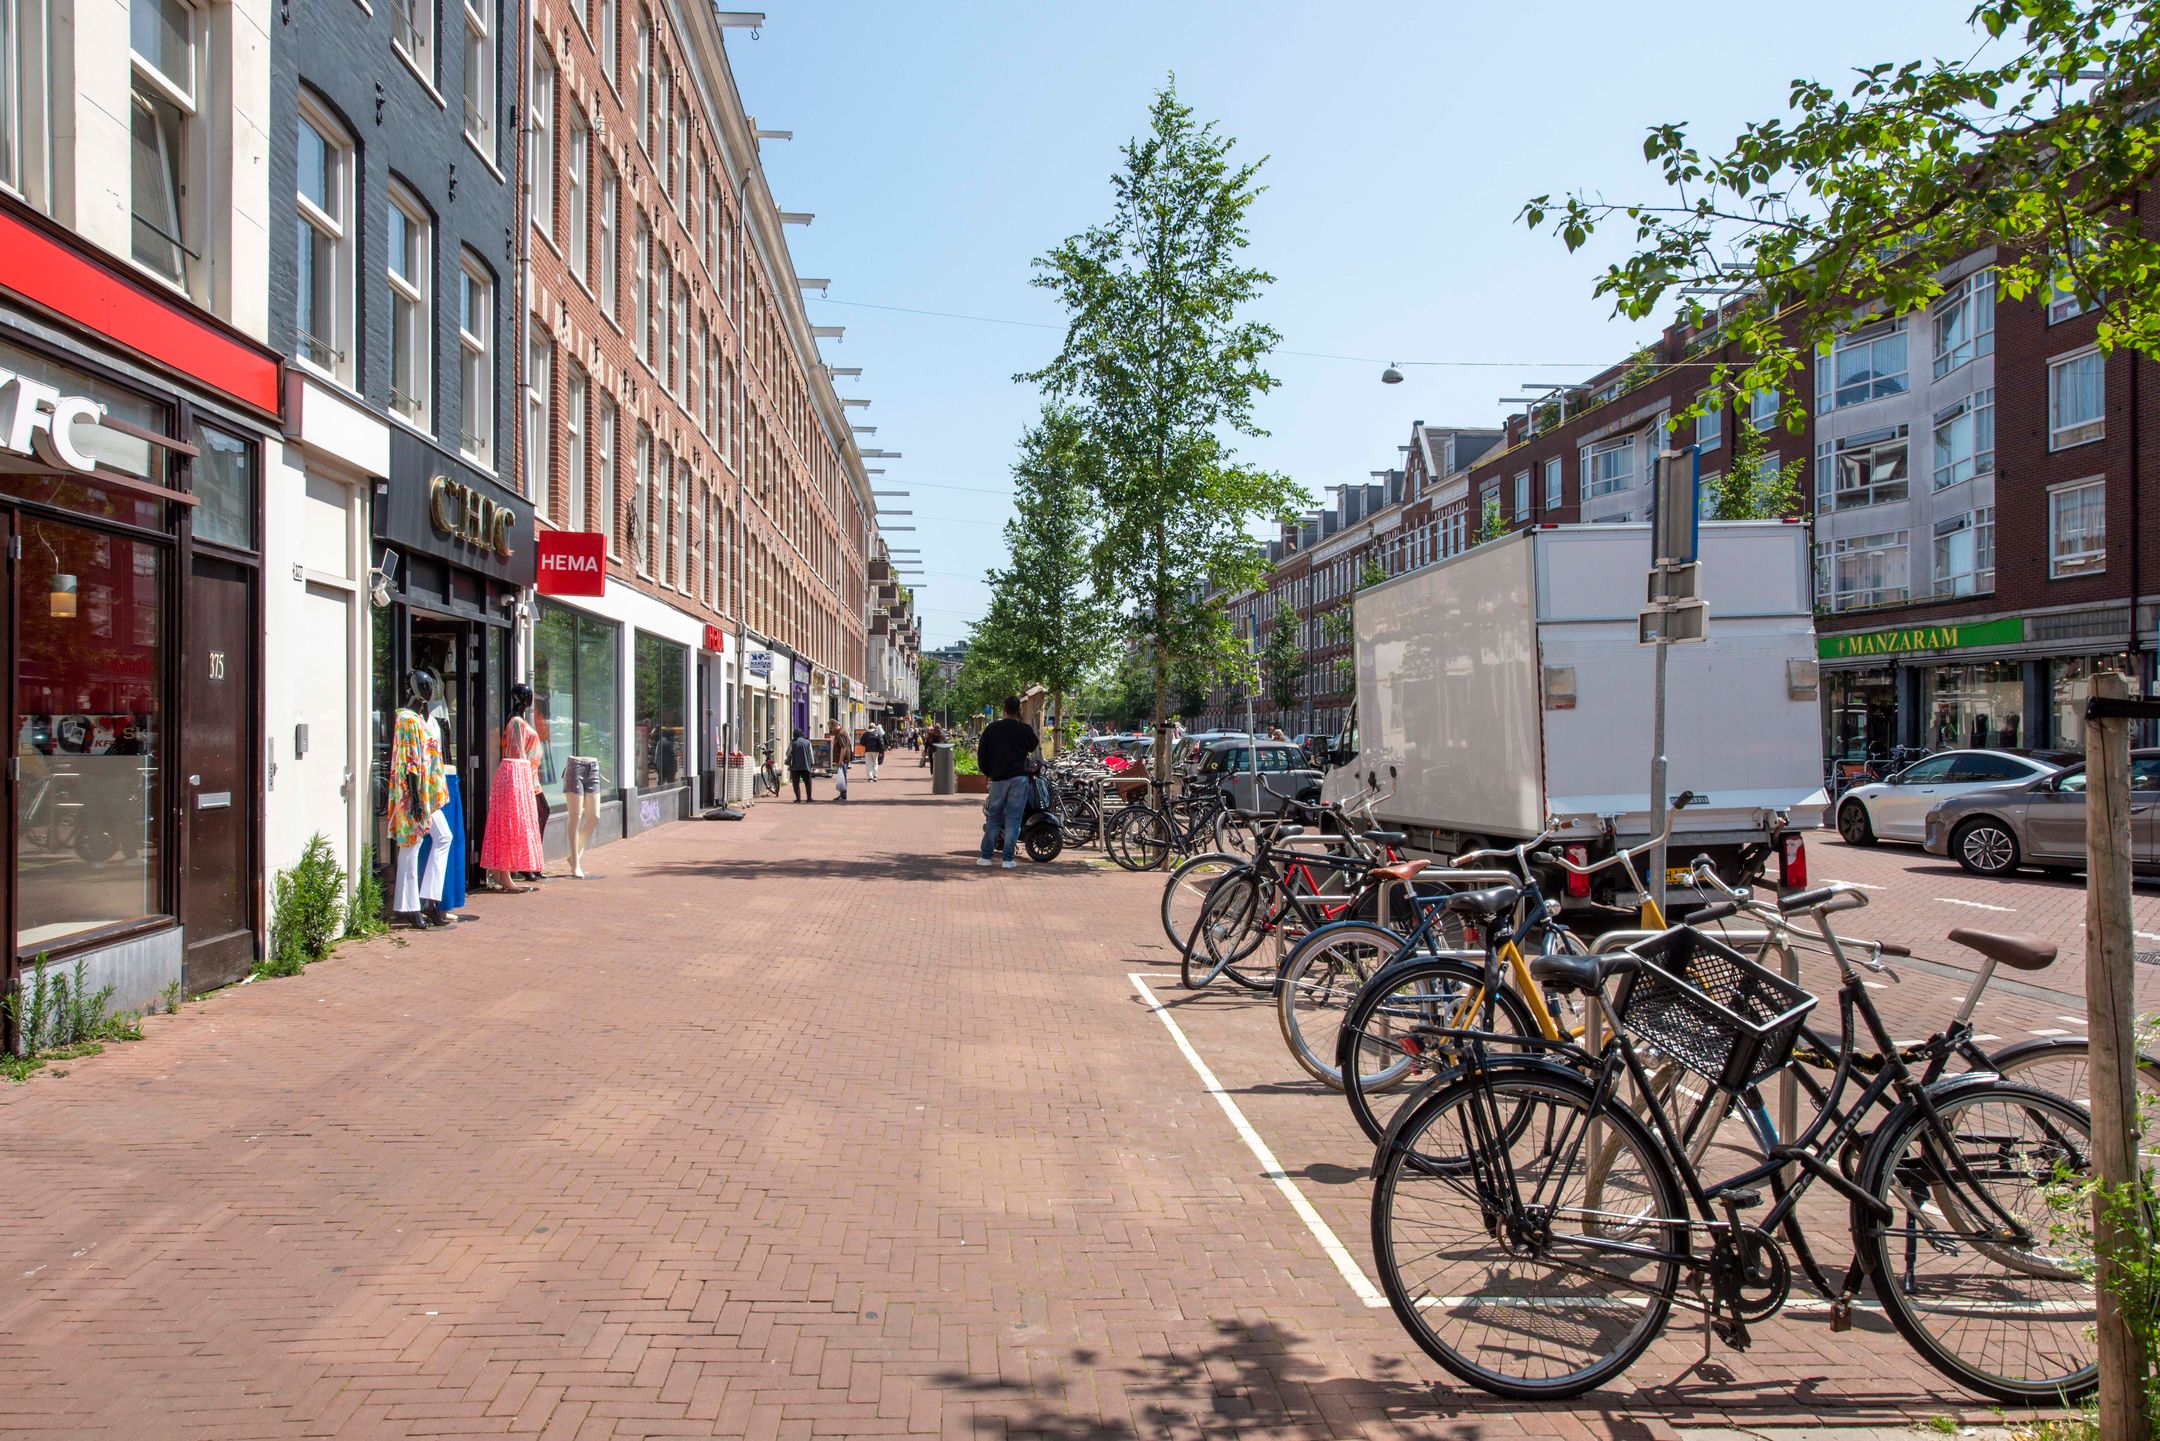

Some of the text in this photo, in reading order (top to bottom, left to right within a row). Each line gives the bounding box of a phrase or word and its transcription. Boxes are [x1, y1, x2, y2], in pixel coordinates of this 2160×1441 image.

[431, 475, 516, 557] CHIC
[541, 553, 599, 573] HEMA
[1849, 627, 1959, 656] MANZARAM
[209, 652, 224, 679] 375
